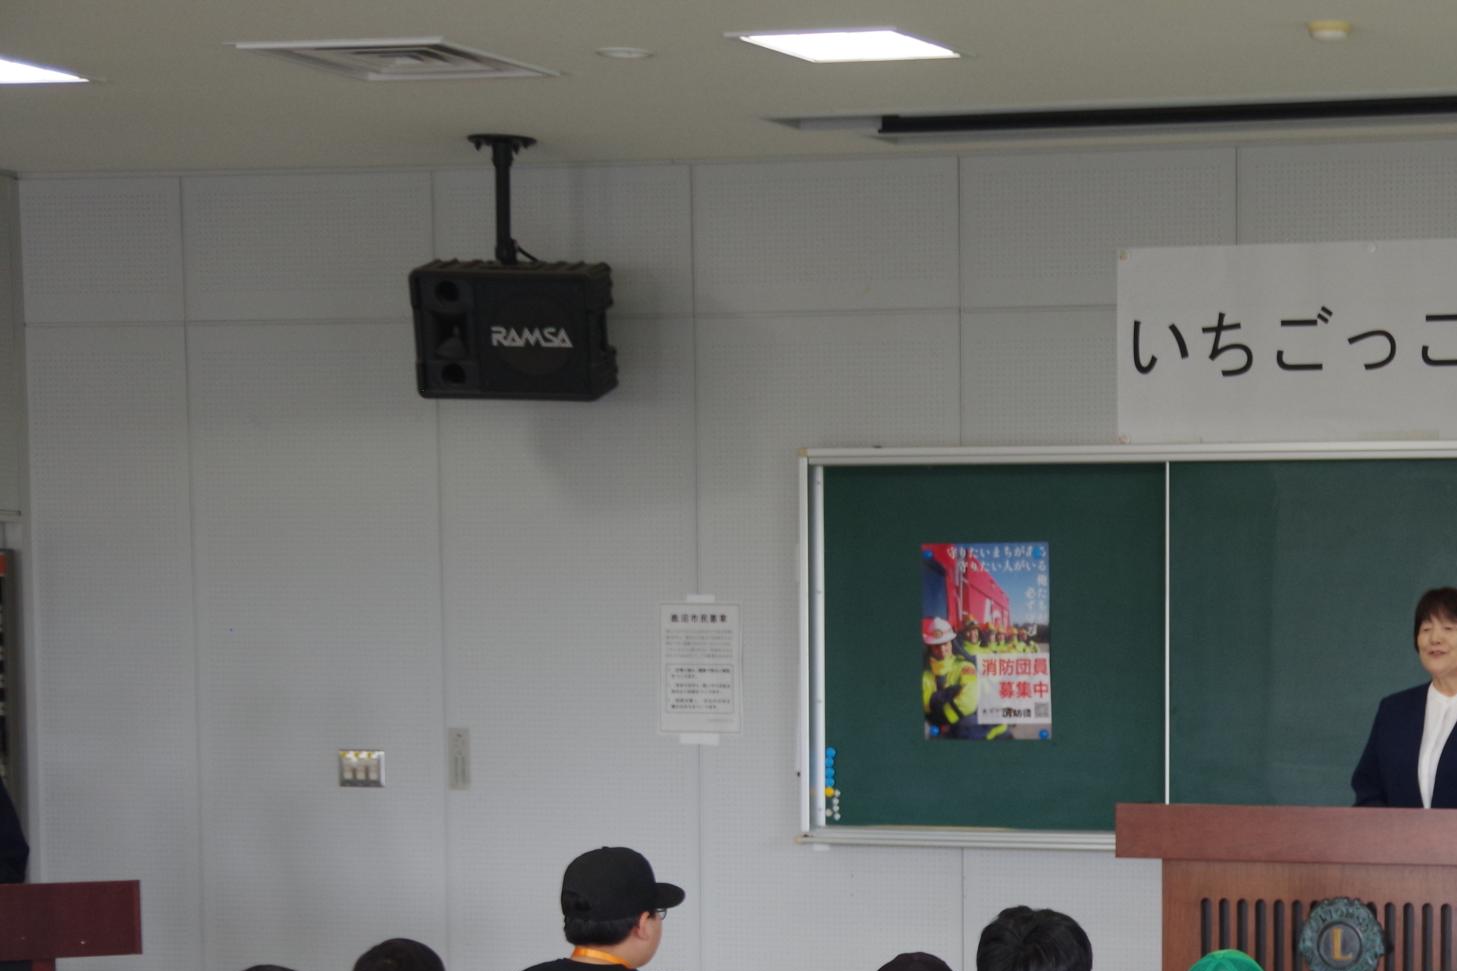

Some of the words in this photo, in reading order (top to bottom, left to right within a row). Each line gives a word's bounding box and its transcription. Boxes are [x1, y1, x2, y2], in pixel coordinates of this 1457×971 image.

[490, 325, 574, 348] RAMSA
[982, 657, 1049, 676] 消防団員
[999, 681, 1049, 699] 募集中
[1332, 927, 1354, 961] L
